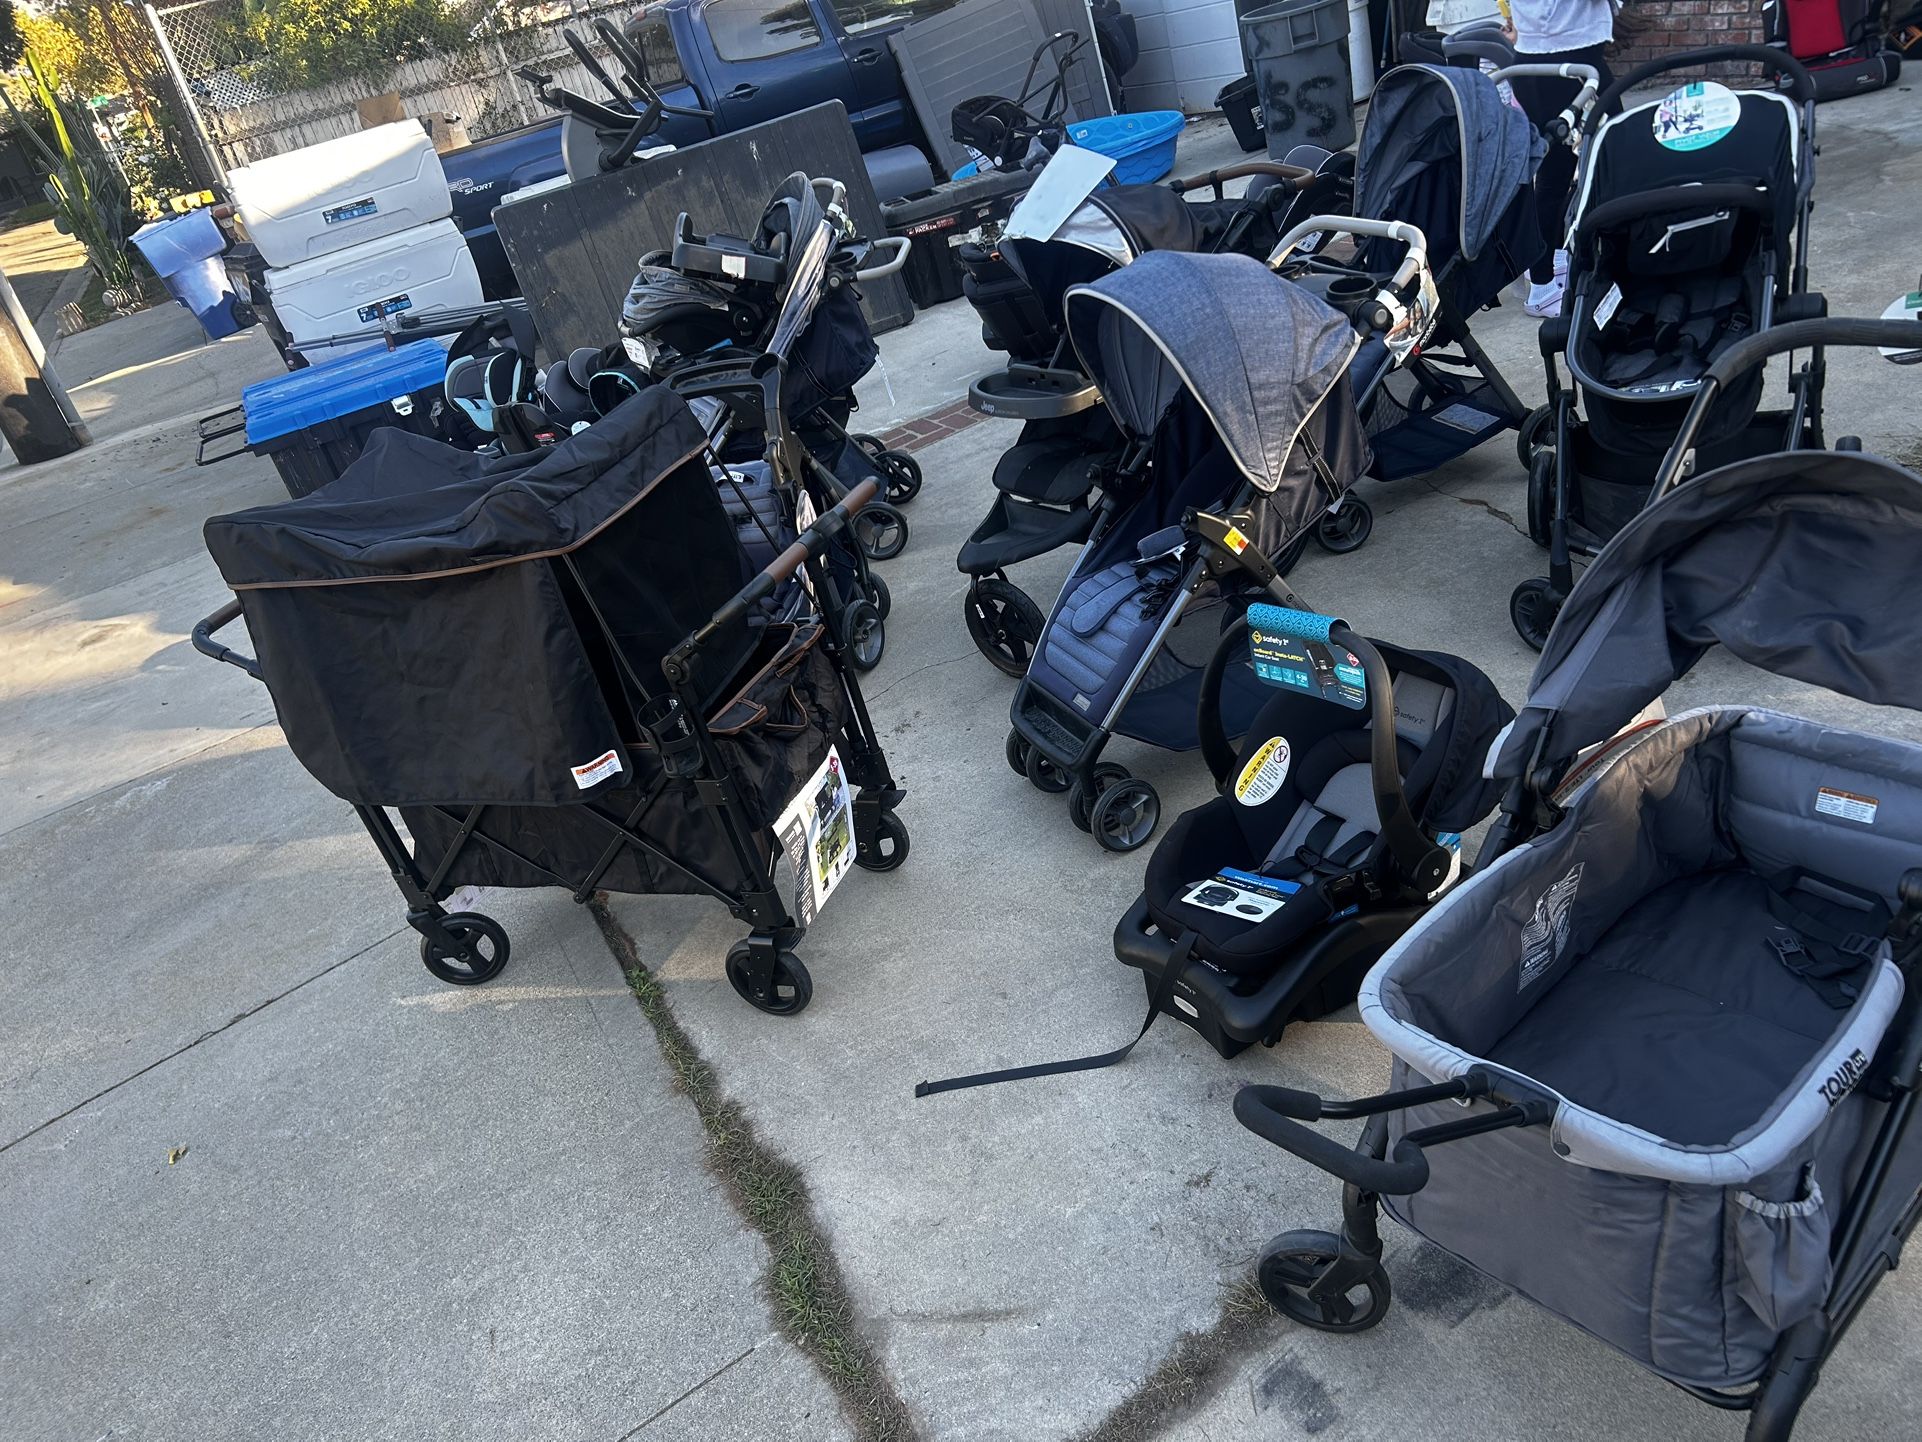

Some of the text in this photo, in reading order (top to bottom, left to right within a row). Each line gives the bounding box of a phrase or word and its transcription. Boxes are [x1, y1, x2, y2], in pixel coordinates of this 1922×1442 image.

[448, 177, 474, 192] RD
[464, 181, 494, 195] SPORT
[980, 400, 995, 414] Jeep
[1262, 635, 1283, 646] safety
[1400, 712, 1419, 724] safety
[585, 755, 610, 772] WARNING
[1238, 747, 1272, 791] WARNING
[1226, 879, 1247, 889] safety
[1817, 1060, 1859, 1107] TOUR
